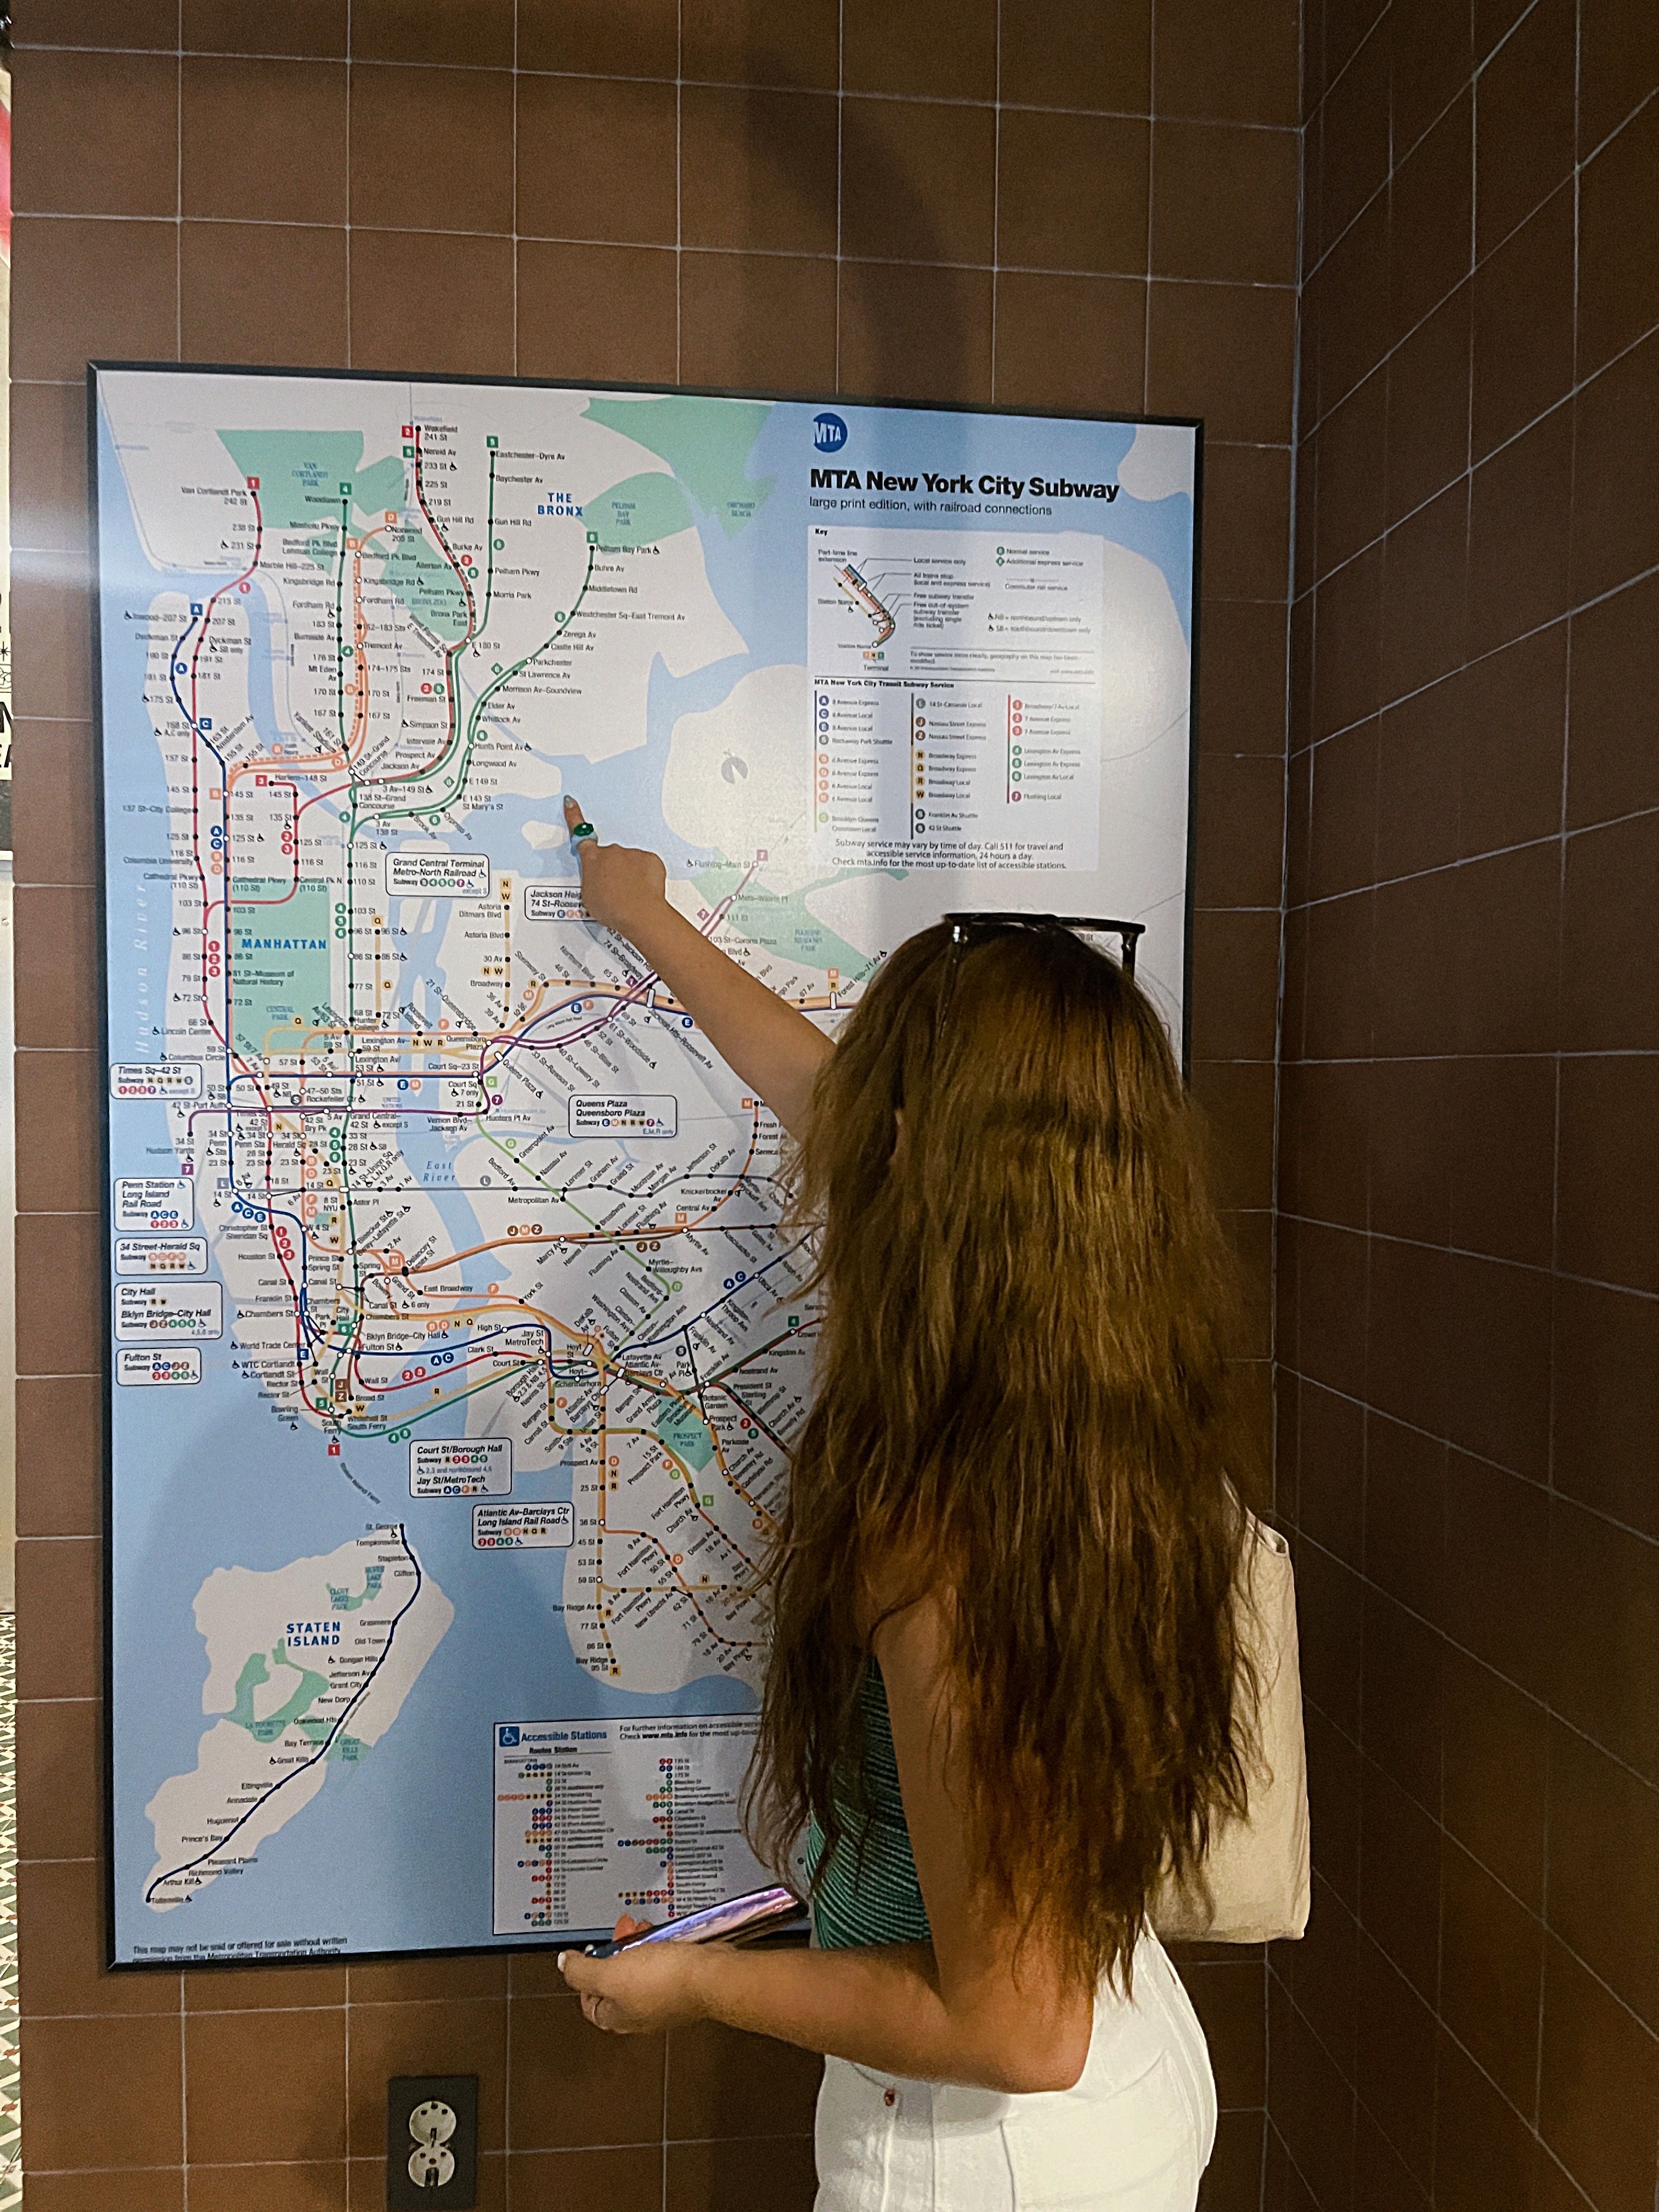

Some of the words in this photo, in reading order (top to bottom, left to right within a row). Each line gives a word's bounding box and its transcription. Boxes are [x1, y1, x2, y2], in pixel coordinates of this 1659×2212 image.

[814, 420, 842, 444] MTA
[811, 469, 861, 489] MTA
[867, 471, 918, 492] New
[923, 473, 973, 494] York
[979, 475, 1025, 499] City
[1029, 477, 1119, 502] Subway
[548, 493, 572, 503] THE
[537, 505, 583, 516] BRONX
[810, 496, 837, 510] large
[840, 499, 865, 511] print
[870, 498, 910, 512] edition,
[914, 501, 936, 511] with
[940, 501, 981, 513] railroad
[984, 503, 1052, 516] connections
[577, 610, 616, 618] Westchester
[648, 612, 675, 621] Tremont
[836, 839, 865, 848] Subway
[930, 842, 939, 850] by
[933, 851, 977, 860] information,
[1019, 853, 1032, 861] day.
[393, 859, 418, 867] Grand
[420, 859, 449, 867] Central
[857, 858, 887, 867] mta.info
[393, 868, 442, 877] Metro-North
[444, 869, 476, 877] Railroad
[134, 882, 148, 951] River
[241, 938, 326, 949] MANHATTAN
[135, 967, 150, 1054] Hudson
[145, 1066, 170, 1075] Sq-42
[427, 1161, 452, 1170] East
[424, 1173, 456, 1182] River
[123, 1190, 143, 1199] Long
[190, 1243, 200, 1252] Sq
[121, 1288, 137, 1297] City
[121, 1311, 144, 1319] Bklyn
[146, 1310, 195, 1318] Bridge-City
[125, 1353, 151, 1362] Fulton
[153, 1353, 161, 1361] St
[417, 1446, 439, 1454] Court
[442, 1445, 488, 1454] St/Borough
[417, 1477, 430, 1485] Jay
[433, 1476, 485, 1485] St/MetroTech
[478, 1509, 507, 1517] Atlantic
[510, 1508, 555, 1516] Av-Barclays
[478, 1519, 496, 1527] Long
[478, 1528, 502, 1537] Subway
[286, 1622, 340, 1634] STATEN
[287, 1635, 340, 1647] ISLAND
[521, 1731, 568, 1742] Accessible
[572, 1730, 607, 1740] Stations
